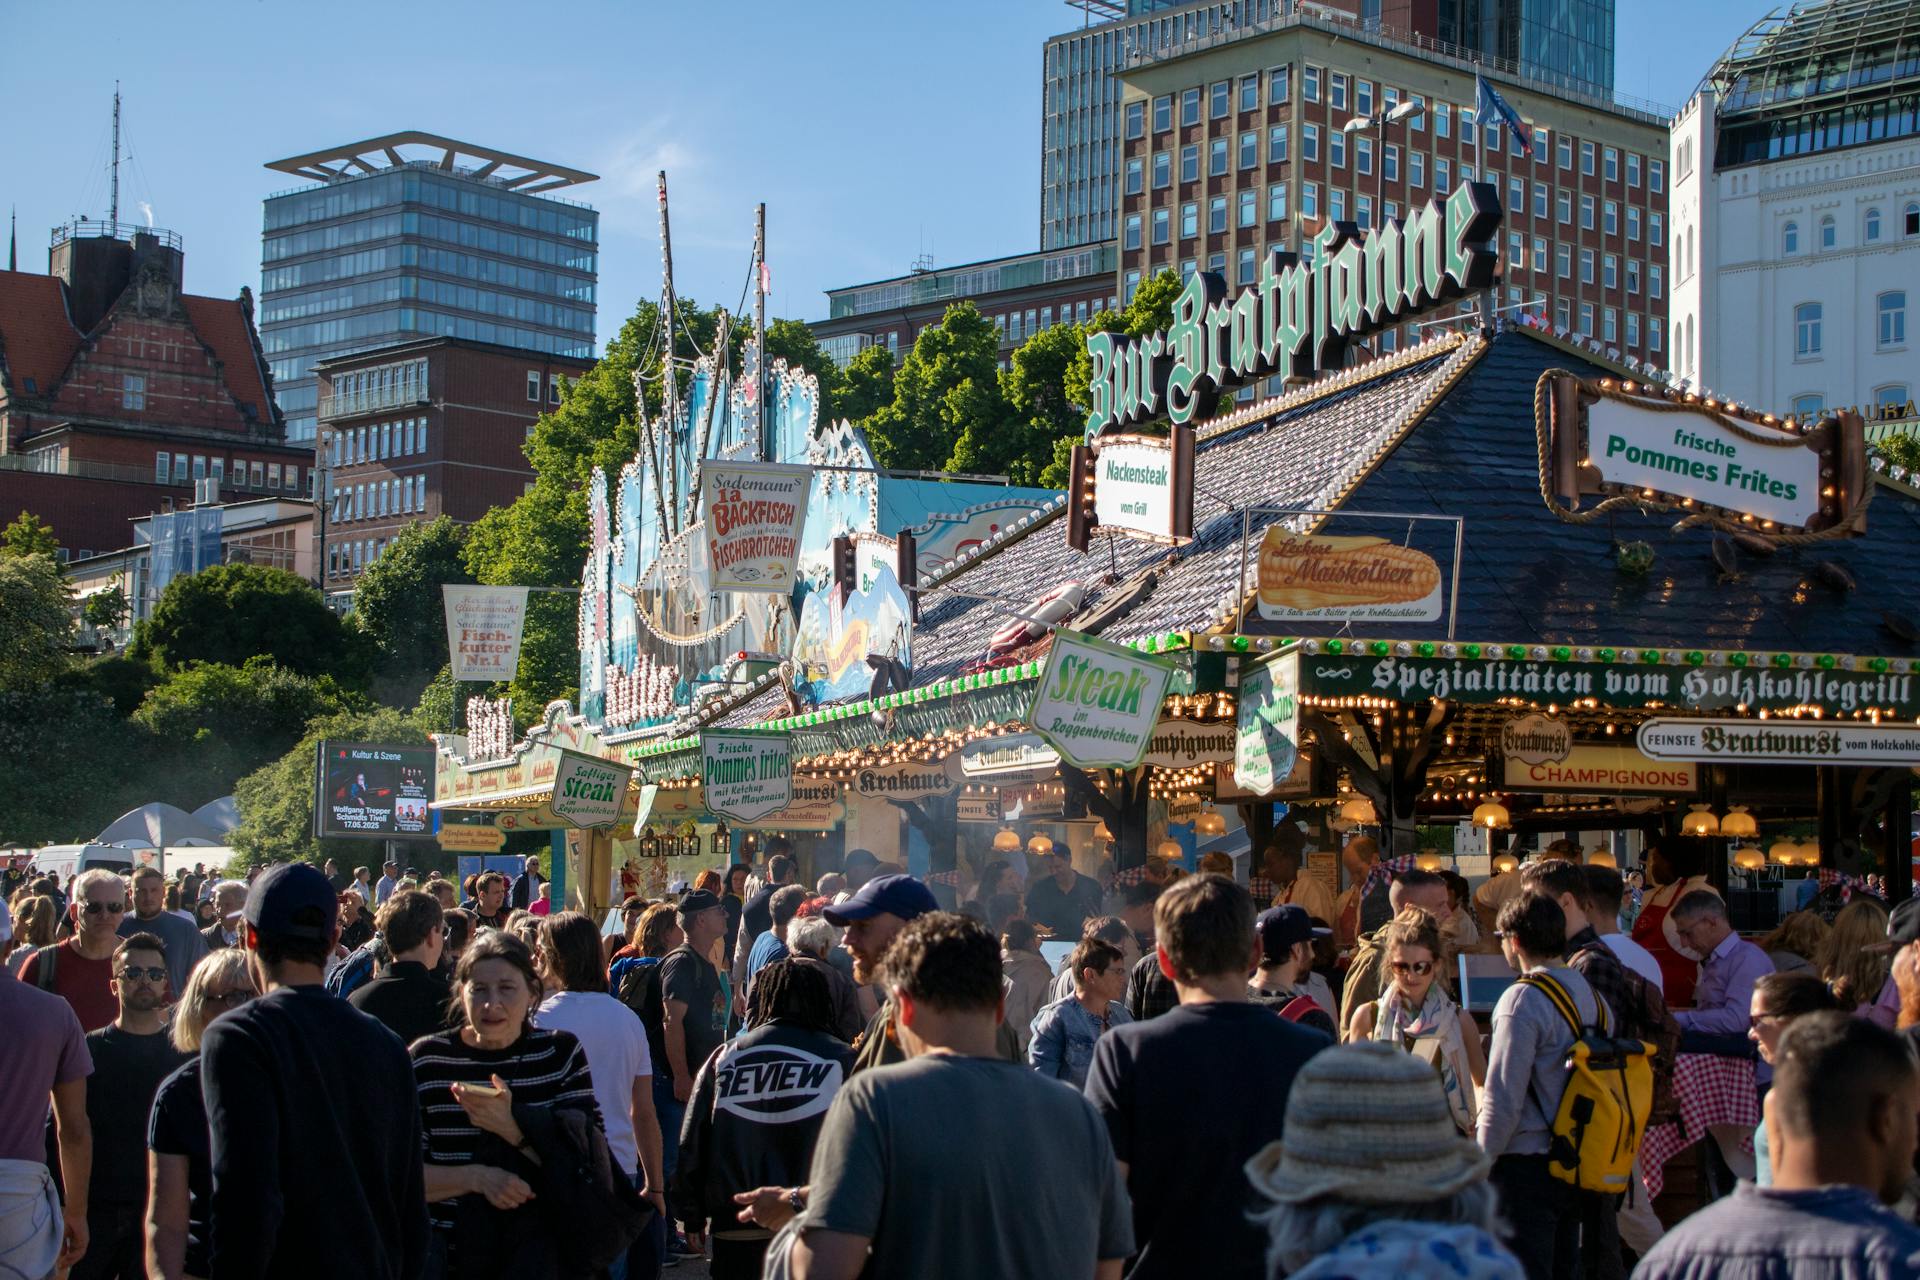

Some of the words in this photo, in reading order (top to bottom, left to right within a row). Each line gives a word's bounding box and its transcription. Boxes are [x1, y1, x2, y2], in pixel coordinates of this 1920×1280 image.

[1084, 330, 1165, 446] Zur
[1167, 180, 1480, 424] Bratpfanne
[1674, 428, 1736, 458] frische
[1106, 459, 1168, 486] Nackensteak
[1606, 434, 1718, 482] Pommes
[1725, 463, 1798, 501] Frites
[1120, 502, 1133, 513] vom
[1134, 502, 1148, 516] Grill
[1272, 537, 1333, 557] Leckere
[1284, 559, 1414, 587] Maiskolben
[462, 629, 512, 641] Fisch-
[458, 642, 513, 654] kutter
[1050, 653, 1150, 718] Steak
[1372, 657, 1592, 698] Spezialitäten
[1605, 669, 1669, 696] vom
[1680, 669, 1911, 711] Holzkohlegrill
[1073, 708, 1089, 723] im
[1050, 717, 1140, 744] Roggenbrötchen
[1504, 725, 1567, 753] Bratwurst
[1648, 734, 1696, 746] FEINSTE
[1701, 727, 1842, 755] Bratwurst
[1845, 740, 1867, 751] vom
[351, 750, 372, 759] Kultur
[373, 751, 379, 759] &
[380, 752, 402, 760] Szene
[718, 742, 753, 754] Frische
[576, 766, 617, 781] Saftiges
[705, 755, 757, 786] Pommes
[760, 749, 790, 781] frites
[1529, 765, 1689, 786] CHAMPIGNONS
[562, 776, 617, 803] Steak
[714, 787, 728, 797] mit
[731, 784, 764, 795] Ketchup
[721, 796, 739, 807] oder
[333, 805, 365, 815] Wolfgang
[366, 806, 391, 816] Trepper
[336, 813, 368, 822] Schmidts
[369, 814, 387, 822] Tivoli
[717, 1062, 834, 1099] REVIEW
